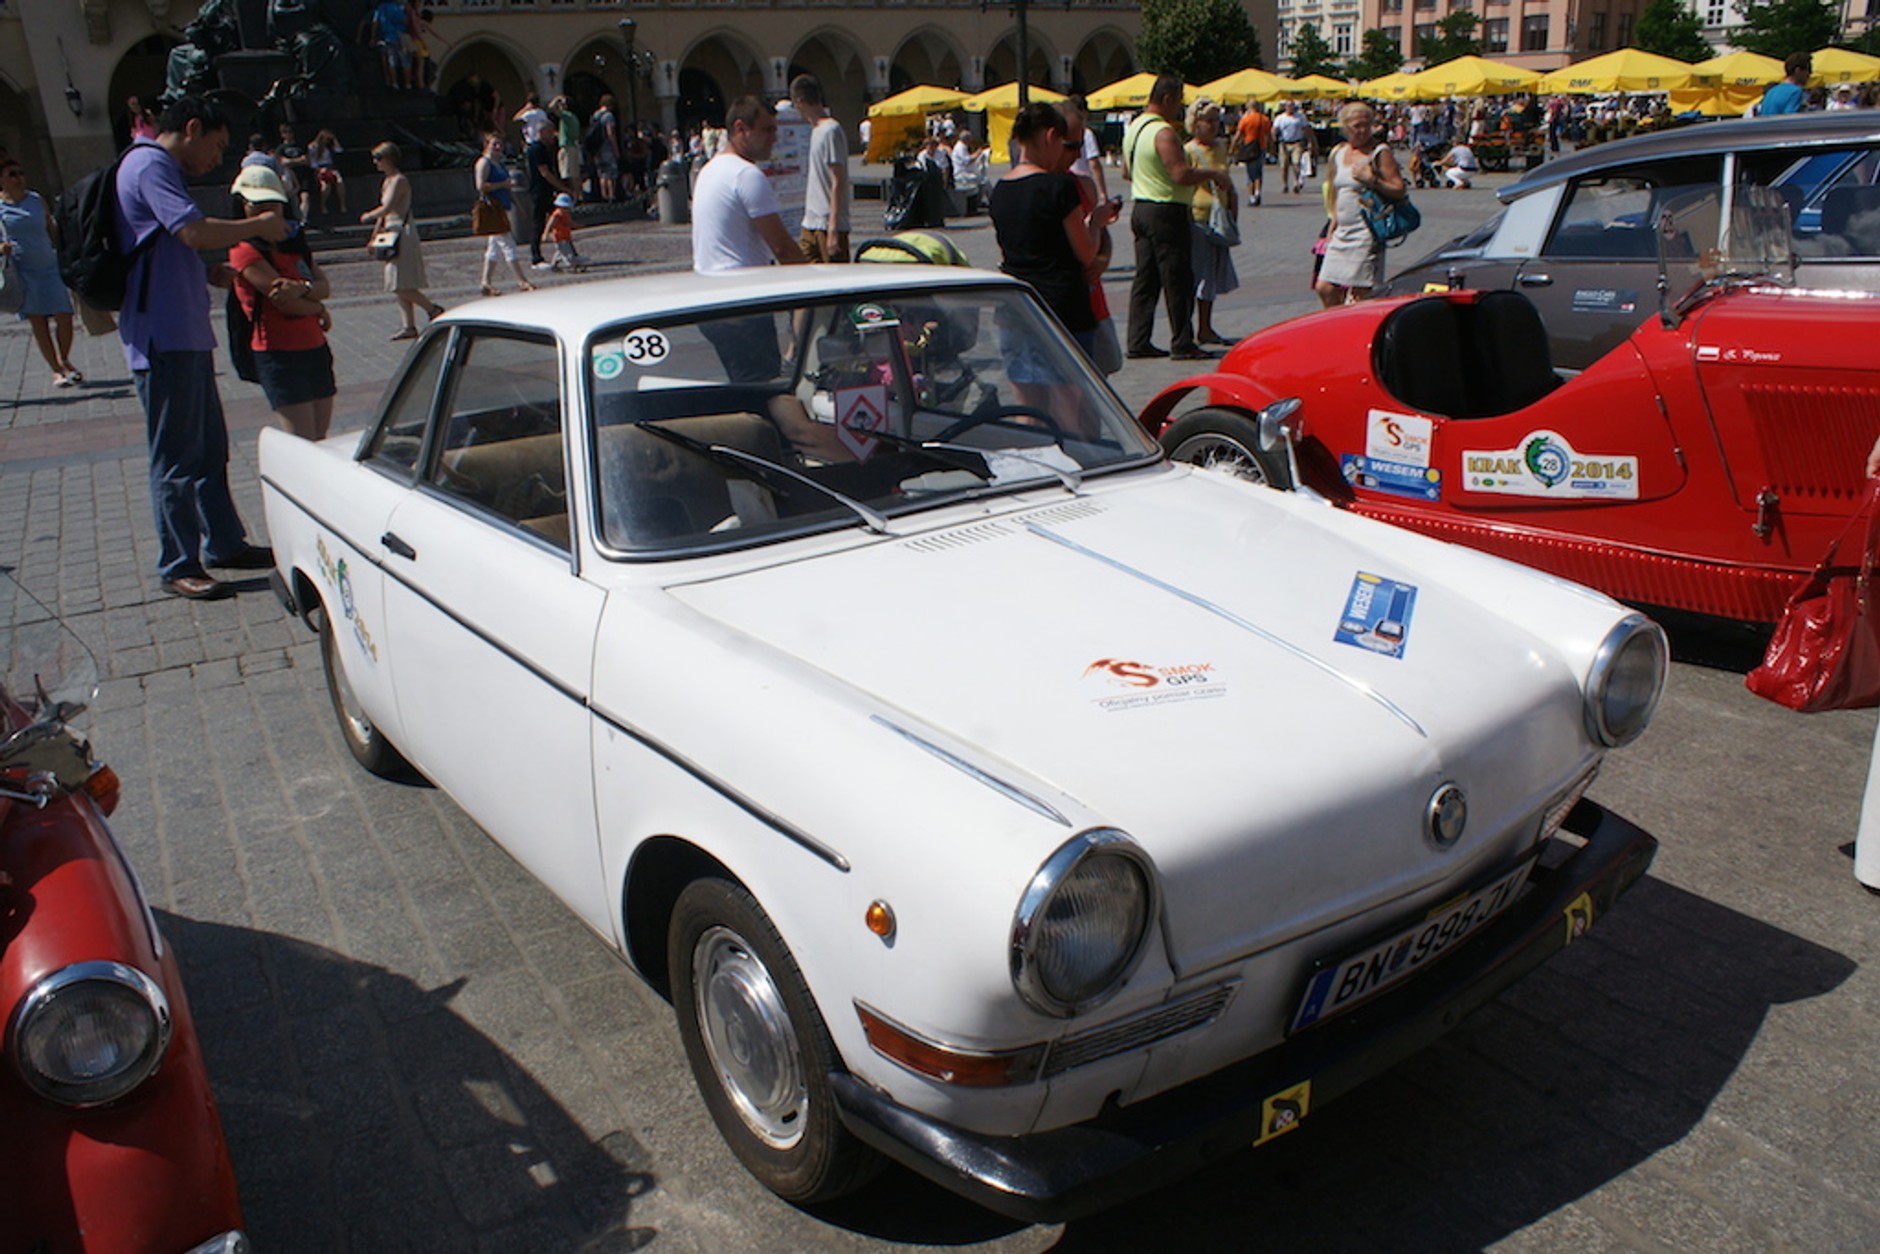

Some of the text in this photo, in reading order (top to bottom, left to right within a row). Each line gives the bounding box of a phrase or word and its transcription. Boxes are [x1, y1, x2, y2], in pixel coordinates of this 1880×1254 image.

[1569, 79, 1593, 88] RMF
[627, 334, 666, 360] 38
[1403, 441, 1421, 453] GPS
[1371, 460, 1425, 479] WESEM
[1467, 457, 1634, 480] KRAK 28 2014
[1348, 580, 1376, 620] WESEM
[1158, 662, 1216, 677] SMOK
[1166, 673, 1208, 687] GPS
[1334, 945, 1393, 1005] BN
